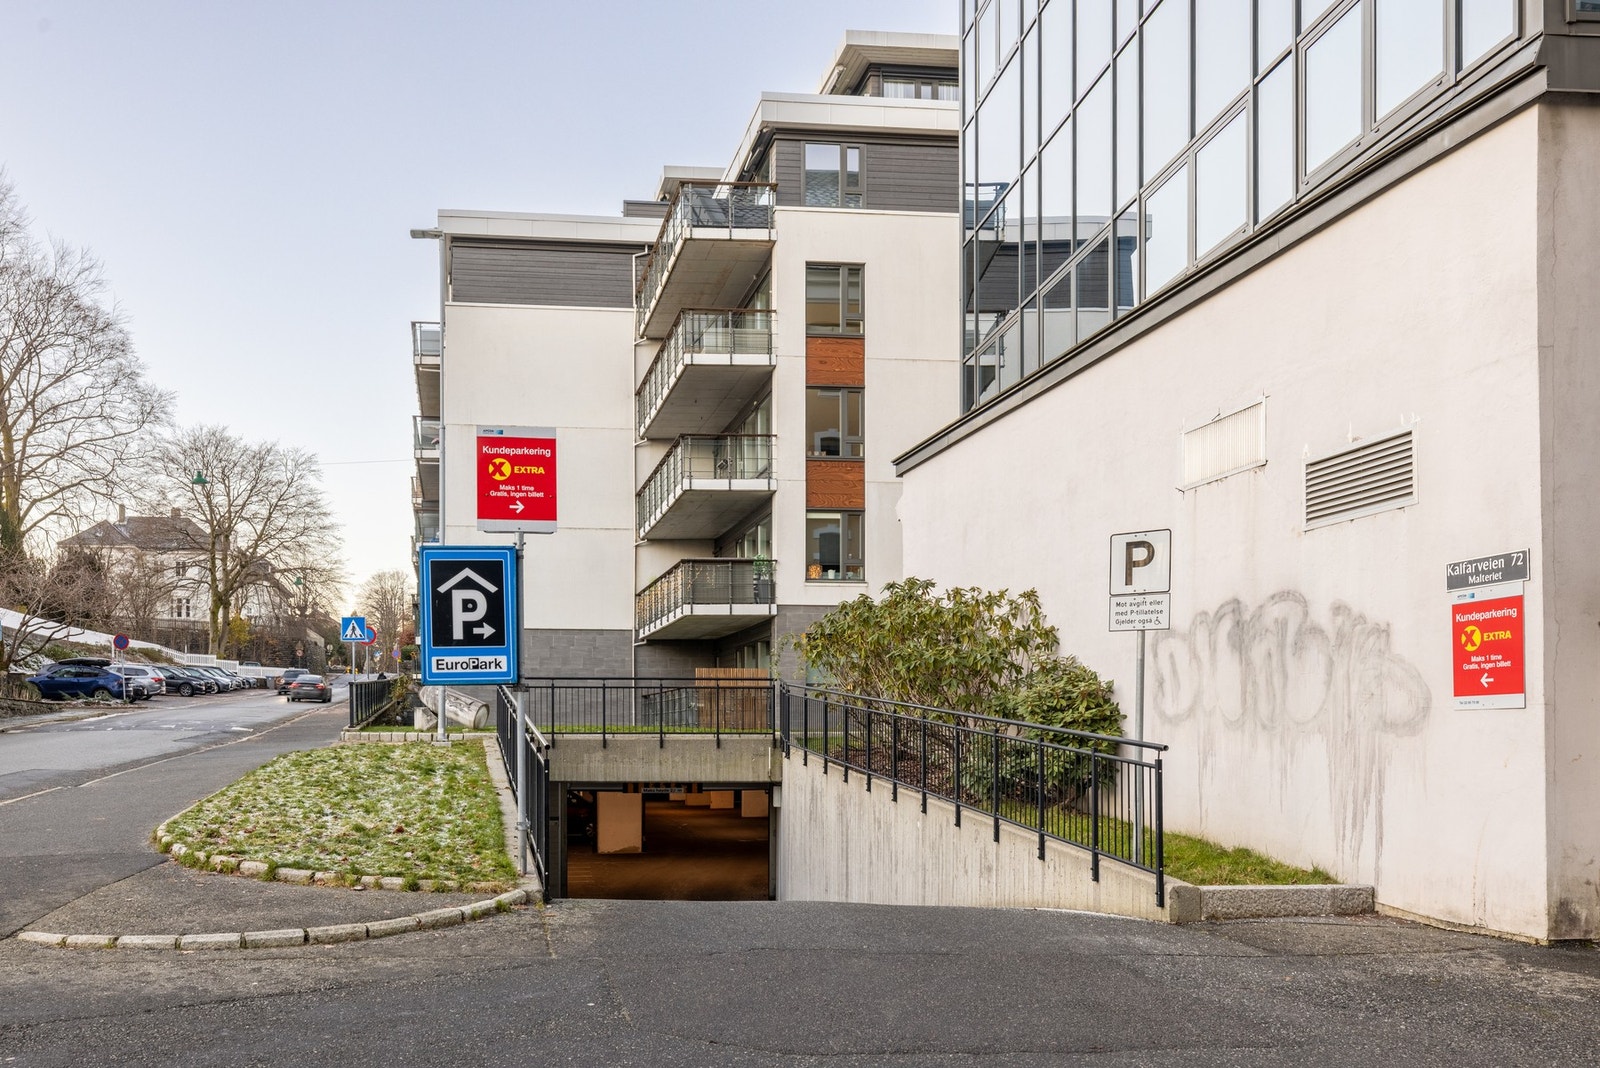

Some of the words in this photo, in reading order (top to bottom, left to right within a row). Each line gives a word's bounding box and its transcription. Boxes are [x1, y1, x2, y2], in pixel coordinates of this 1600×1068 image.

[482, 445, 551, 458] Kundeparkering
[514, 466, 545, 474] EXTRA
[510, 490, 527, 498] ingen
[1125, 540, 1155, 586] P
[1447, 558, 1504, 576] Kalfarveien
[1510, 552, 1524, 566] 72
[1468, 572, 1502, 584] Malteriet
[452, 589, 488, 640] P
[1456, 608, 1517, 622] Kundeparkering
[1484, 630, 1512, 641] EXTRA
[436, 658, 502, 671] EuroPark
